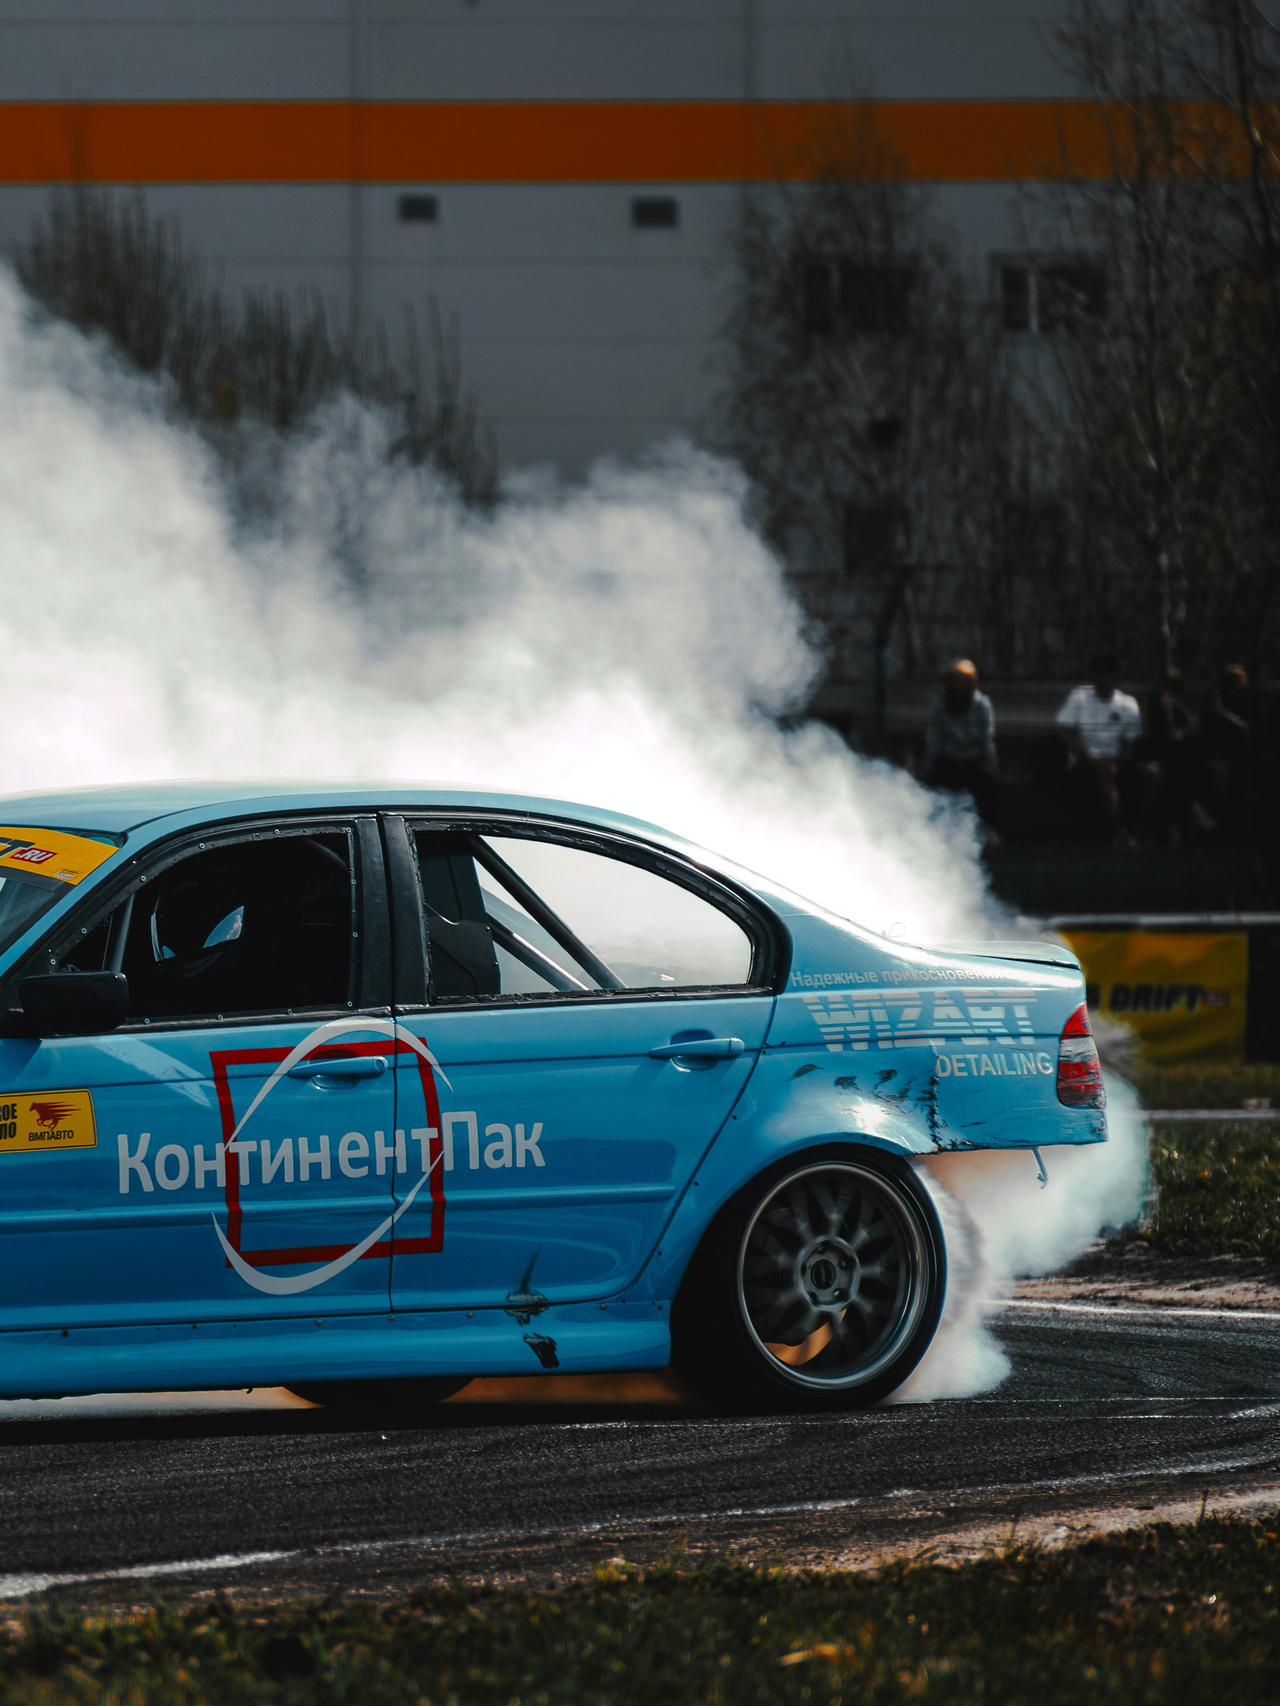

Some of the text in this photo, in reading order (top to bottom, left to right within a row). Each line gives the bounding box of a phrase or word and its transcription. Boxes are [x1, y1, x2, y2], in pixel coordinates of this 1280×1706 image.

[789, 970, 879, 988] Надежные
[936, 1052, 1054, 1078] DETAILING
[28, 1129, 75, 1142] ВМПАВТО
